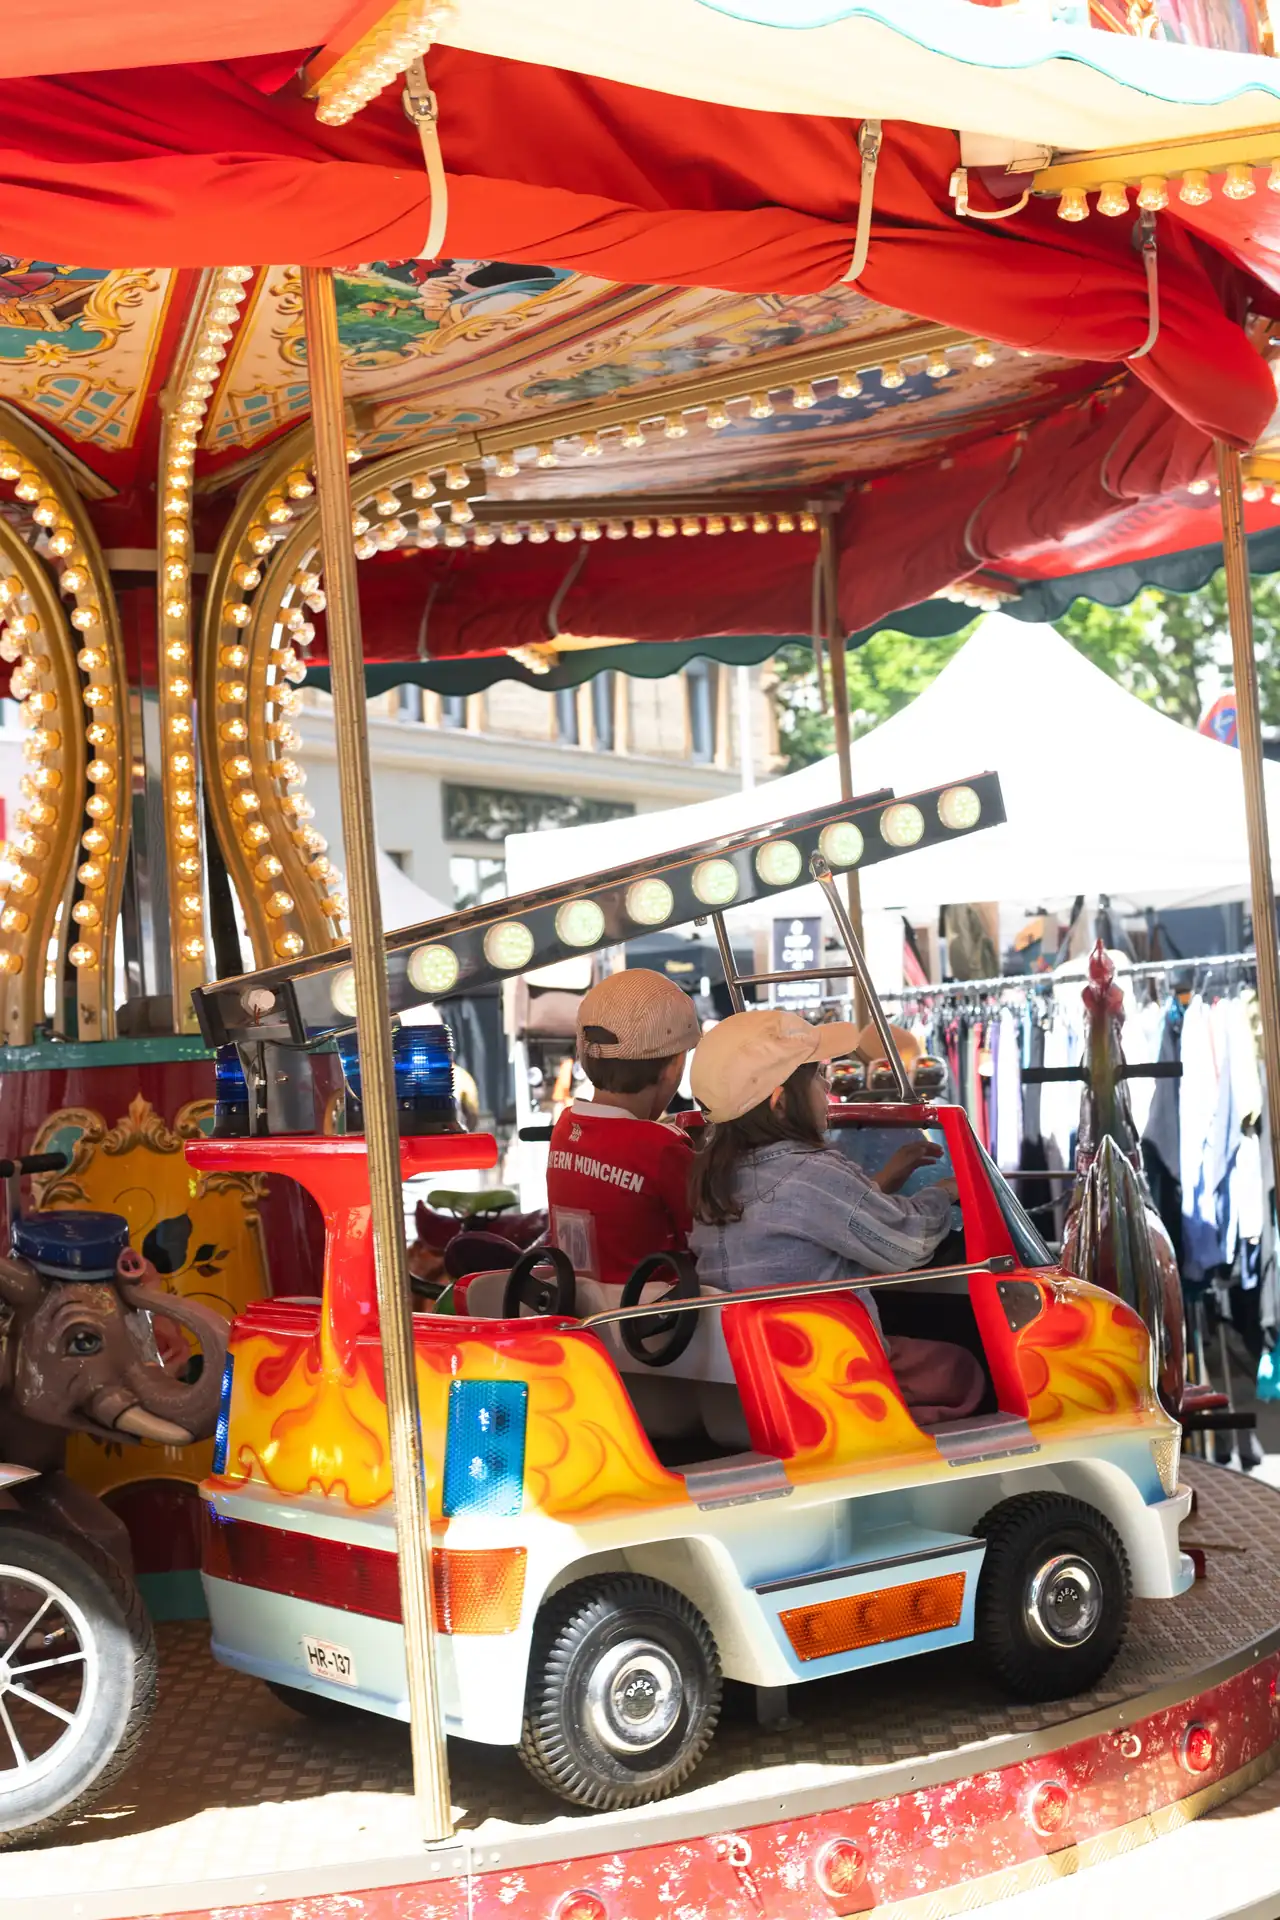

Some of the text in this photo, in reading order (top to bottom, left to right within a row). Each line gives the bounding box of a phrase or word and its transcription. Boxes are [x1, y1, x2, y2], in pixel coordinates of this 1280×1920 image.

[574, 1154, 645, 1193] MÜNCHEN
[1057, 1587, 1078, 1603] DIETZ
[307, 1645, 351, 1676] HR-137
[625, 1680, 654, 1697] DIETZ
